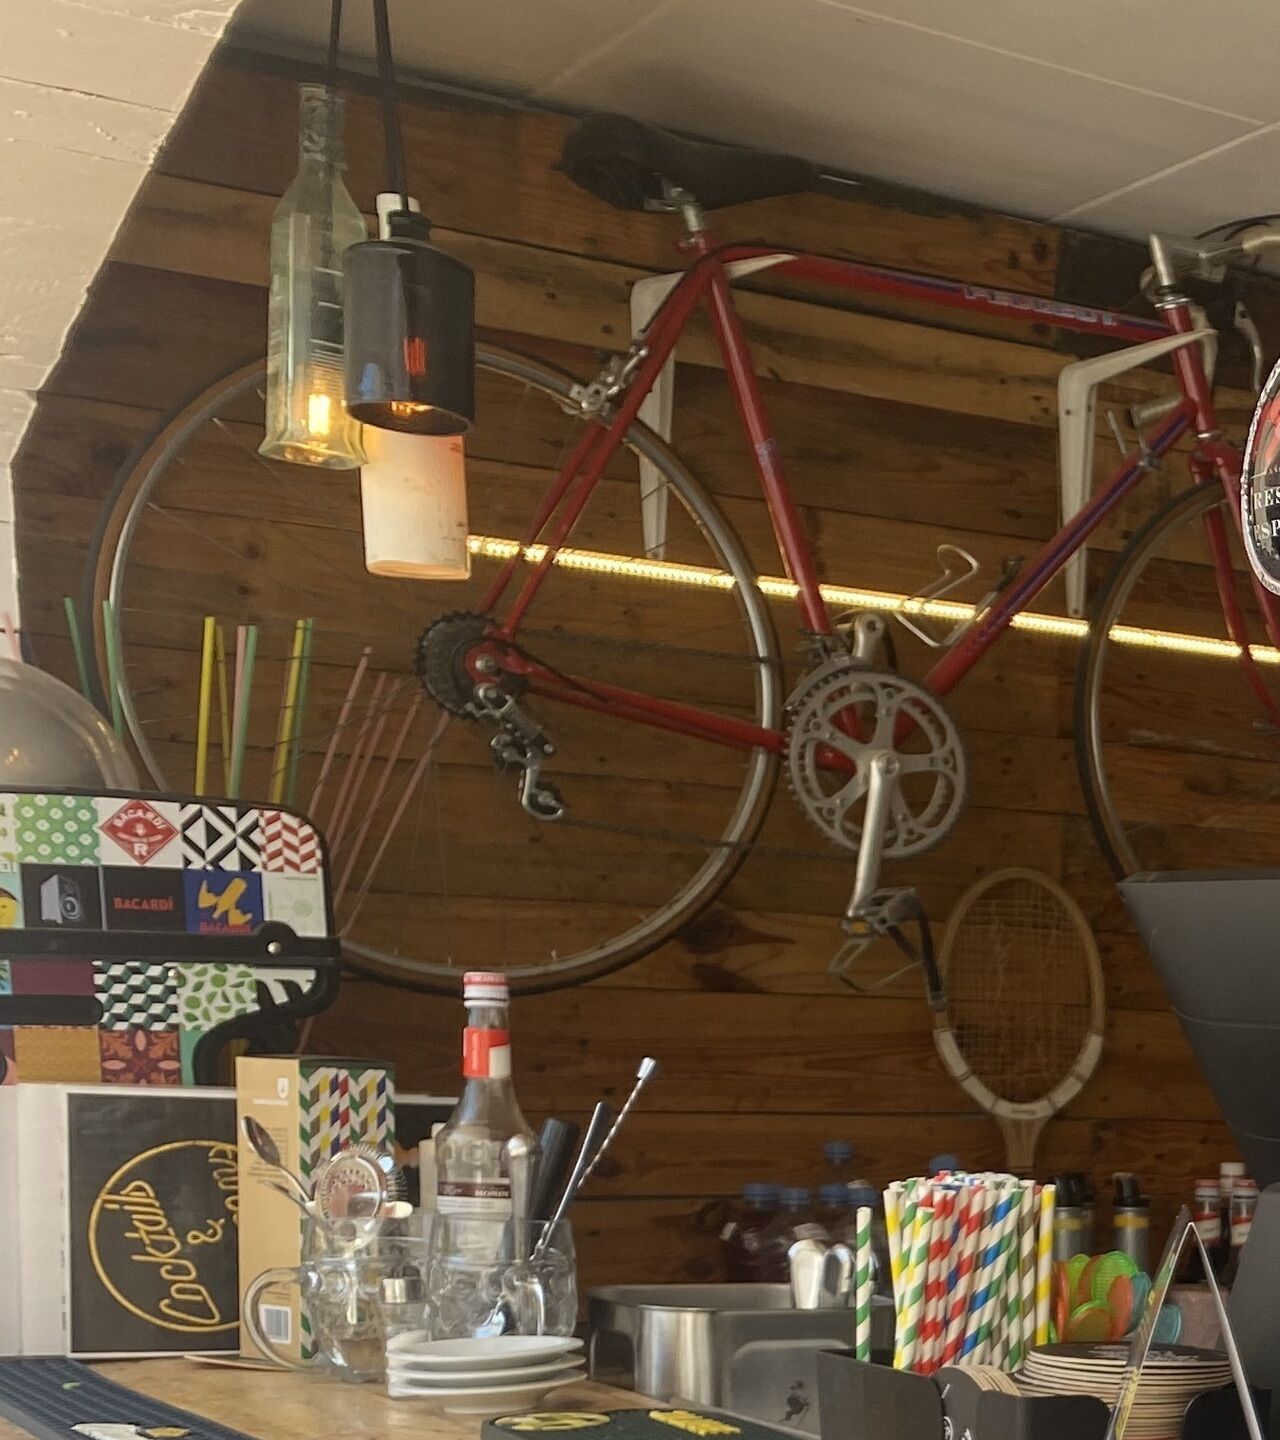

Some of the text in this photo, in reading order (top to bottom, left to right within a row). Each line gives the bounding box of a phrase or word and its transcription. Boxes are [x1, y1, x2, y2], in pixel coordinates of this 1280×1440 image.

[133, 843, 147, 857] R
[113, 896, 174, 912] BACARDÍ
[101, 1180, 220, 1323] Cocktails
[187, 1219, 225, 1244] &
